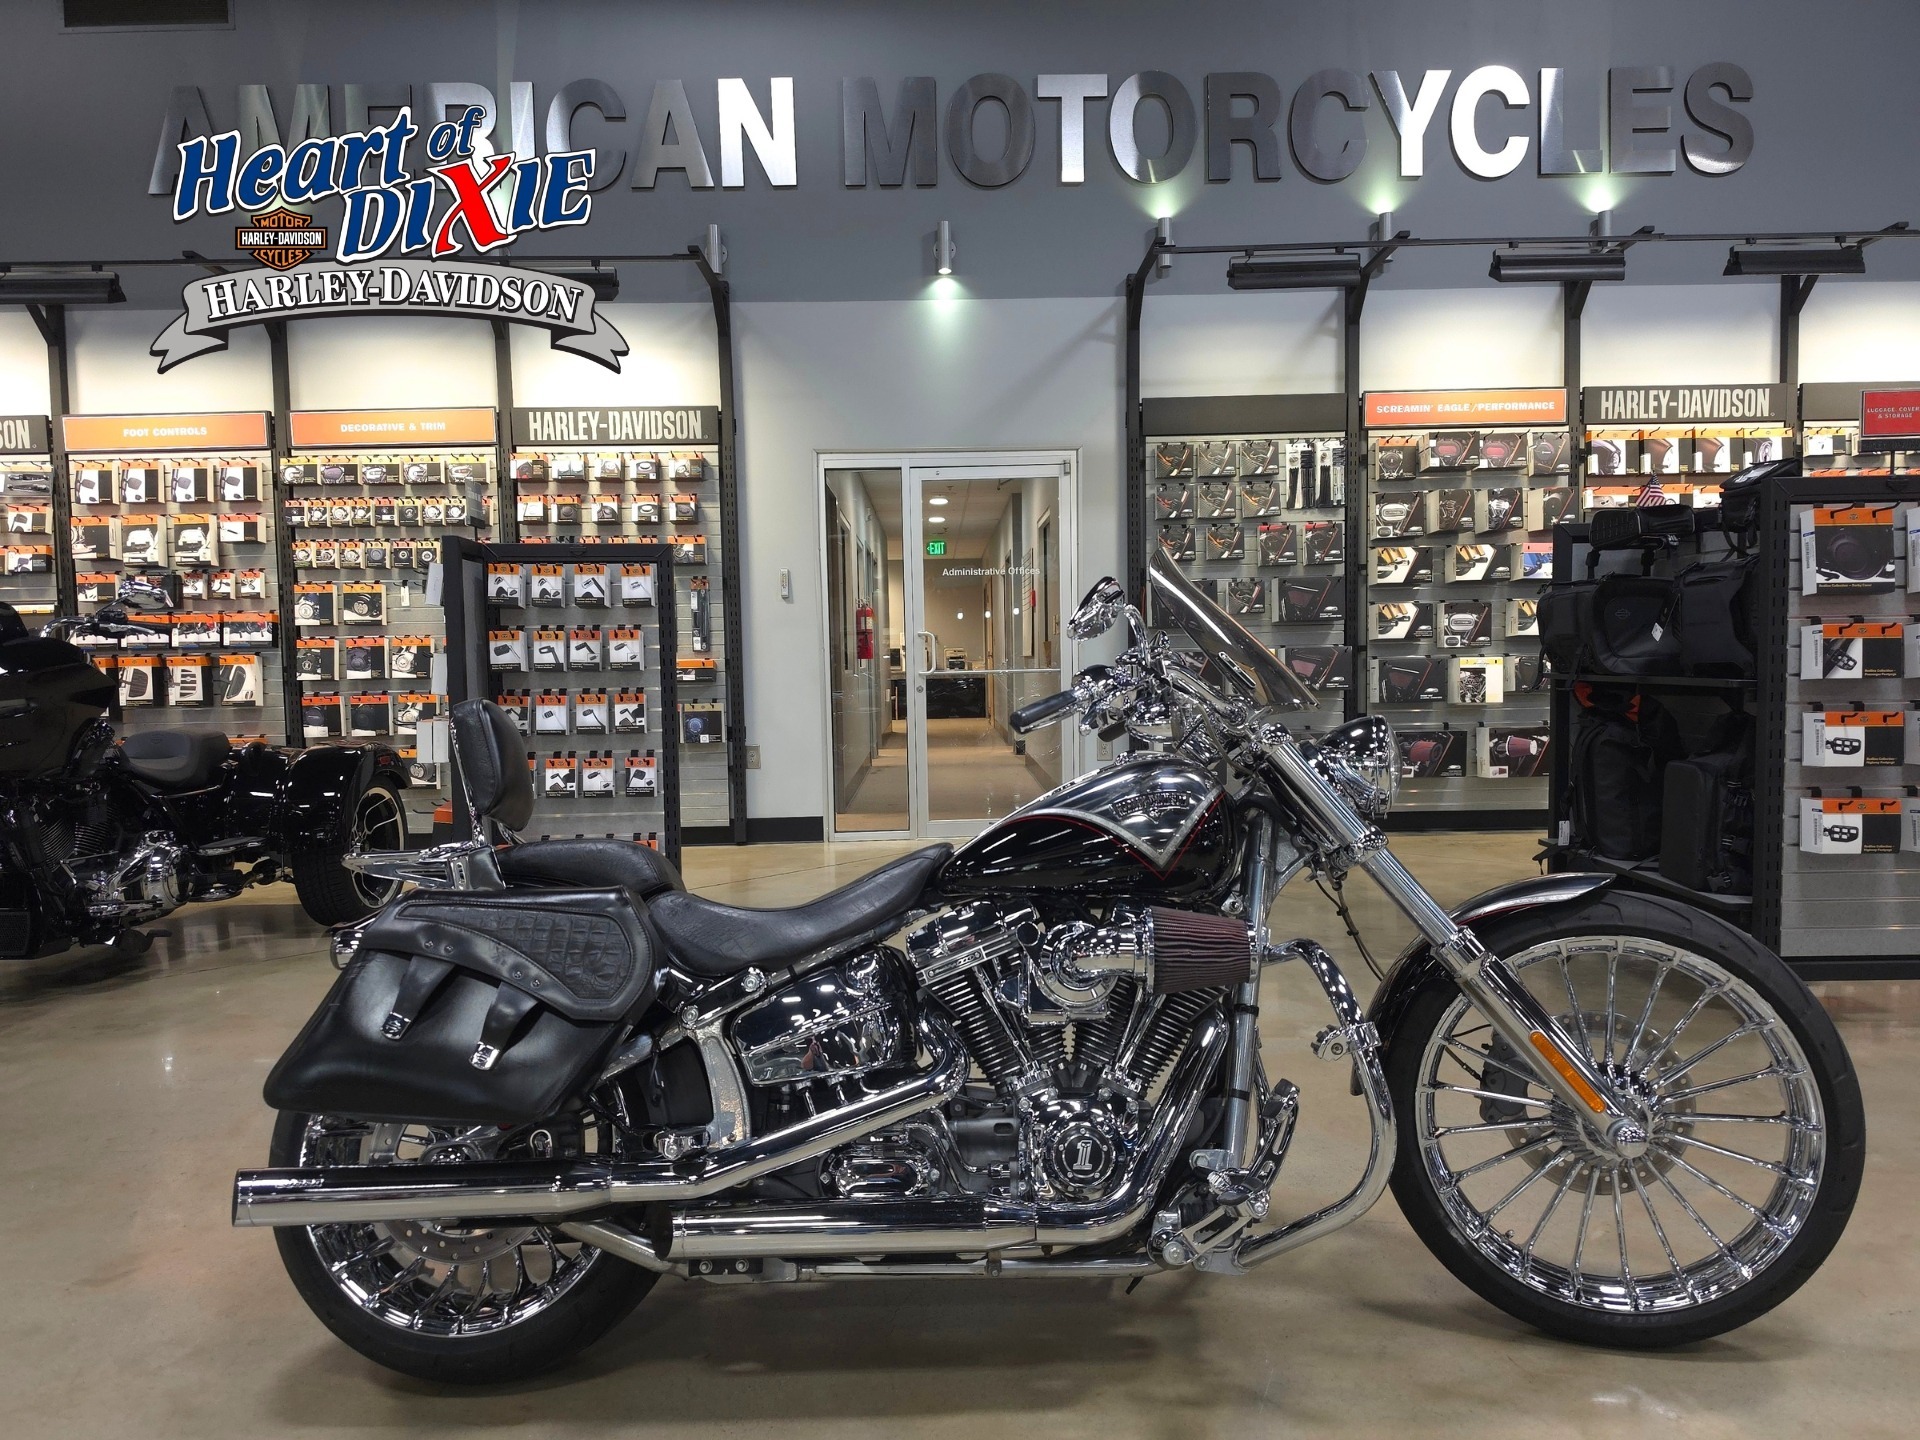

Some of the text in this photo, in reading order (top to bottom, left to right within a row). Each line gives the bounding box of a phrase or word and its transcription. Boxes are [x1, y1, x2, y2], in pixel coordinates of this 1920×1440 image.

[841, 62, 1756, 188] MOTORCYCLES
[1376, 403, 1434, 414] SCREAMIN'
[1600, 388, 1770, 419] HARLEY-DAVIDSON
[123, 426, 207, 437] FOOT CONTROLS
[340, 421, 446, 433] DECORATIVE & TRIM
[528, 410, 702, 441] HARLEY-DAVIDSON
[0, 419, 30, 449] ON
[929, 542, 945, 555] EXIT
[942, 566, 1041, 577] Administrative Offices
